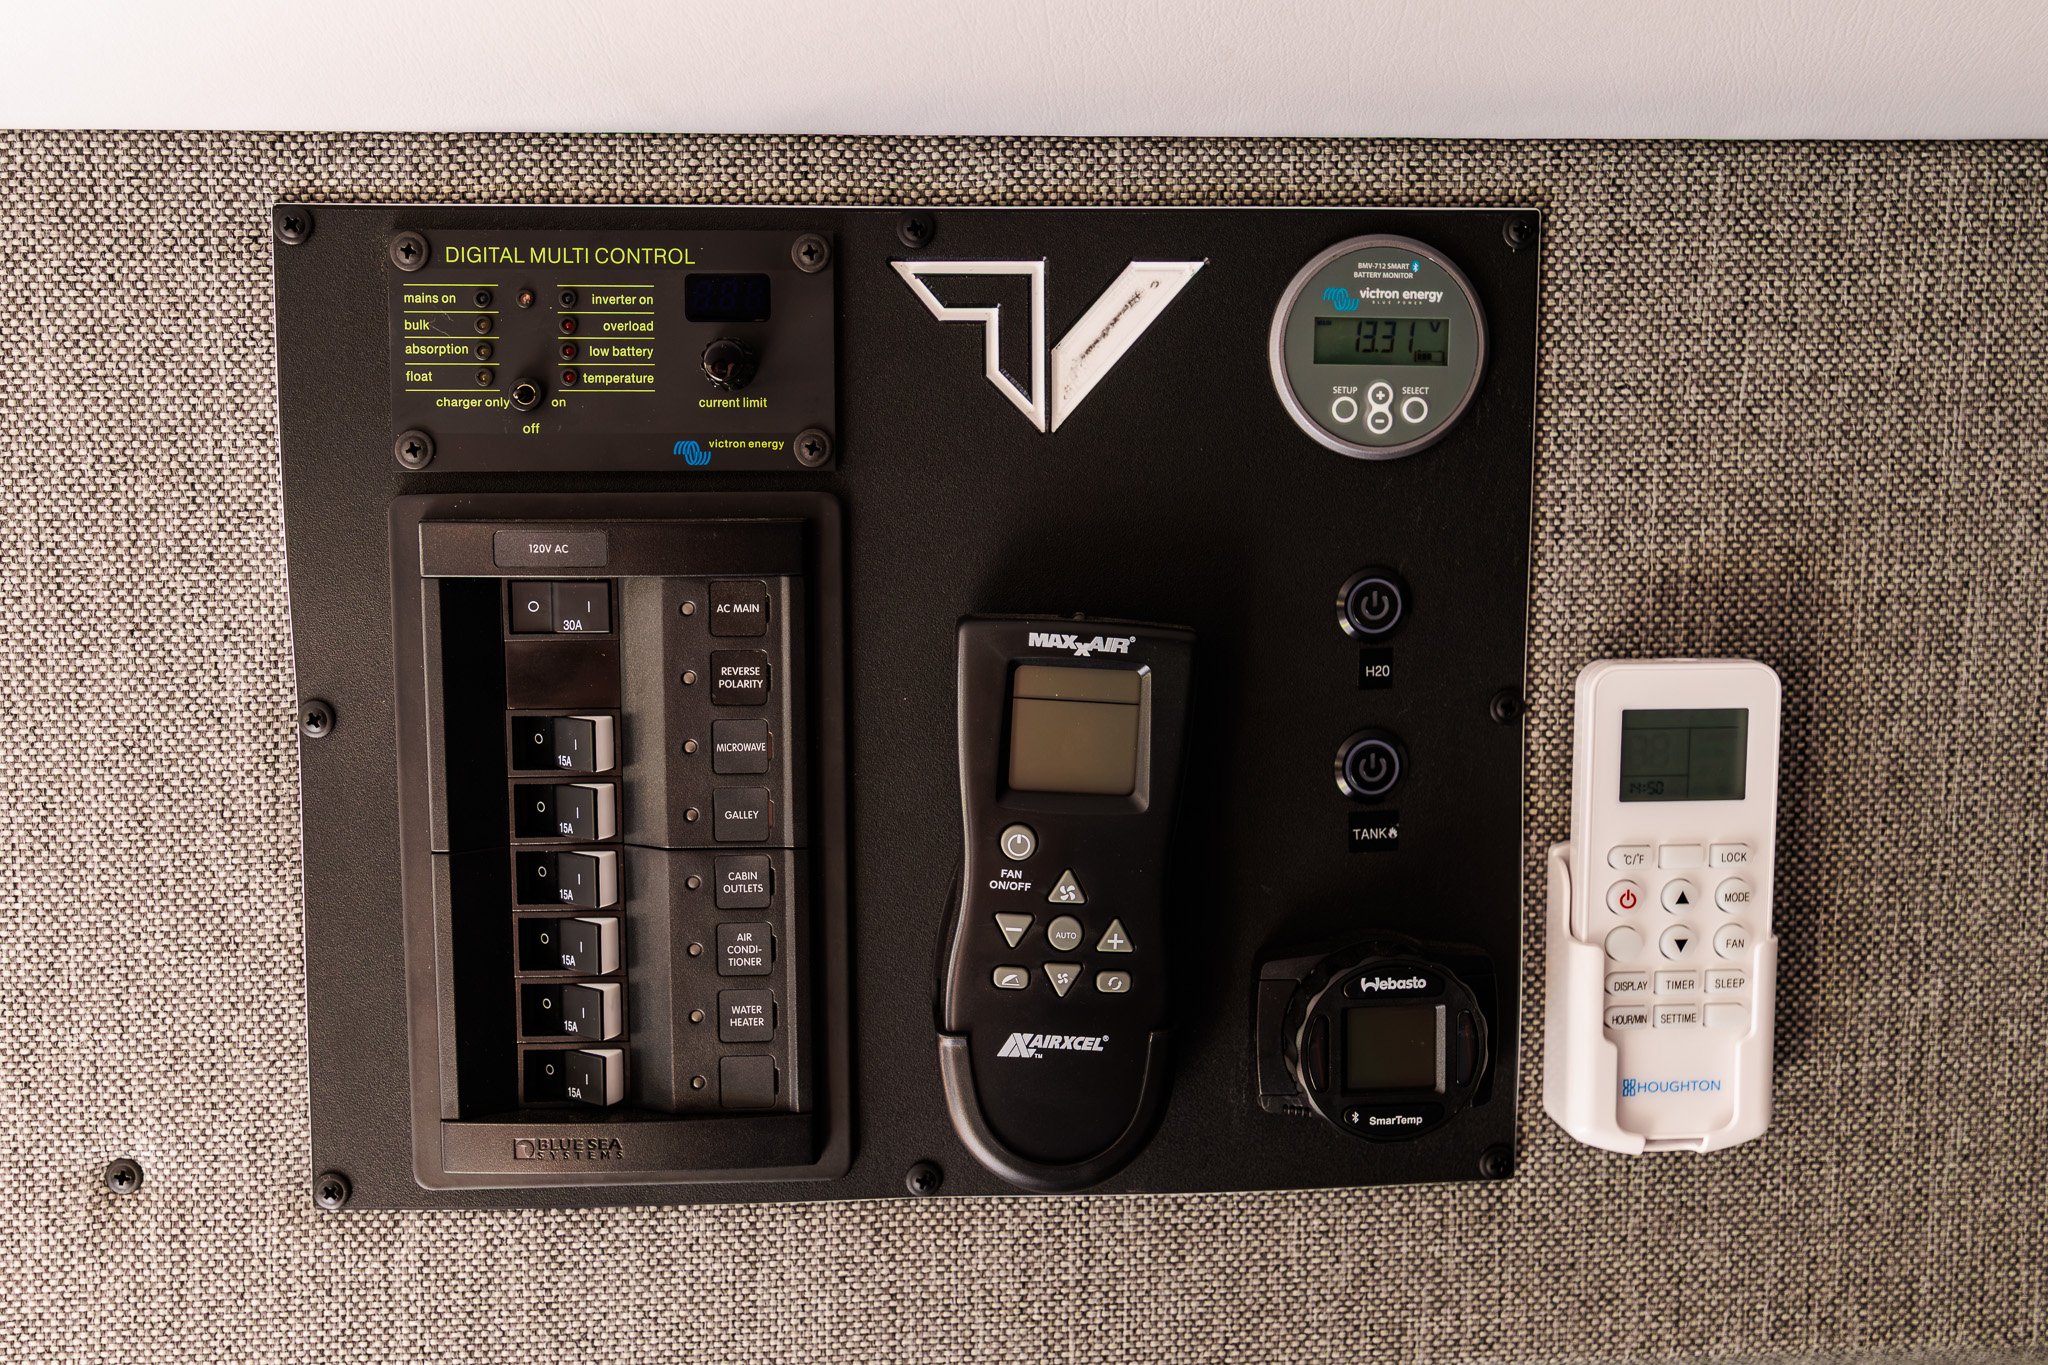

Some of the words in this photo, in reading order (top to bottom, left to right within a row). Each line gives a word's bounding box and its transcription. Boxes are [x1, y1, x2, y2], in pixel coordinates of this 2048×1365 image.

[445, 246, 526, 264] DIGITAL
[530, 247, 589, 264] MULTI
[595, 248, 696, 265] CONTROL
[403, 293, 439, 304] mains
[441, 295, 456, 304] on
[592, 294, 636, 305] inverter
[639, 296, 654, 305] on
[1360, 287, 1400, 299] victron
[1402, 290, 1443, 303] energy
[404, 320, 430, 331] bulk
[603, 320, 654, 332] overload
[1430, 322, 1441, 333] V
[405, 343, 469, 357] absorption
[589, 345, 609, 357] low
[613, 345, 654, 359] battery
[406, 371, 432, 382] float
[583, 373, 654, 386] temperature
[1333, 386, 1358, 394] SETUP
[1402, 387, 1430, 395] SELECT
[436, 398, 482, 410] charger
[485, 396, 510, 409] only
[552, 398, 567, 407] on
[699, 398, 739, 408] current
[742, 397, 768, 408] limit
[523, 423, 540, 435] off
[709, 439, 746, 449] victron
[749, 440, 785, 451] energy
[528, 544, 552, 553] 120V
[554, 544, 569, 553] AC
[716, 604, 731, 613] AC
[733, 604, 760, 613] MAIN
[563, 620, 583, 631] 30A
[721, 667, 760, 676] REVERSE
[718, 680, 763, 689] POLARITY
[716, 742, 766, 753] MICROWAVE
[558, 755, 572, 767] 15A
[724, 810, 760, 820] GALLEY
[559, 823, 573, 834] 15A
[1353, 828, 1387, 840] TANK
[1721, 853, 1747, 863] LOCK
[728, 872, 758, 881] CABIN
[1001, 869, 1022, 879] FAN
[723, 884, 764, 893] OUTLETS
[989, 881, 1032, 891] ON/OFF
[559, 889, 573, 901] 15A
[1724, 892, 1750, 903] MODE
[736, 933, 752, 942] AIR
[1055, 931, 1077, 940] AUTO
[1726, 939, 1745, 949] FAN
[727, 945, 763, 955] CONDI-
[561, 954, 576, 966] 15A
[728, 957, 762, 967] TIONER
[1360, 976, 1427, 992] Webasto
[1614, 981, 1648, 992] DISPLAY
[1666, 980, 1695, 990] TIMER
[1715, 978, 1745, 989] SLEEP
[731, 1005, 762, 1014] WATER
[729, 1017, 765, 1027] HEATER
[1612, 1015, 1648, 1025] HOUR/MIN
[564, 1020, 578, 1032] 15A
[1637, 1080, 1721, 1093] HOUGHTON
[567, 1087, 582, 1099] 15A
[1369, 1115, 1423, 1126] SmarTemp
[538, 1138, 584, 1150] BLUE
[587, 1138, 623, 1150] SEA
[537, 1151, 624, 1160] SYSTEMS
